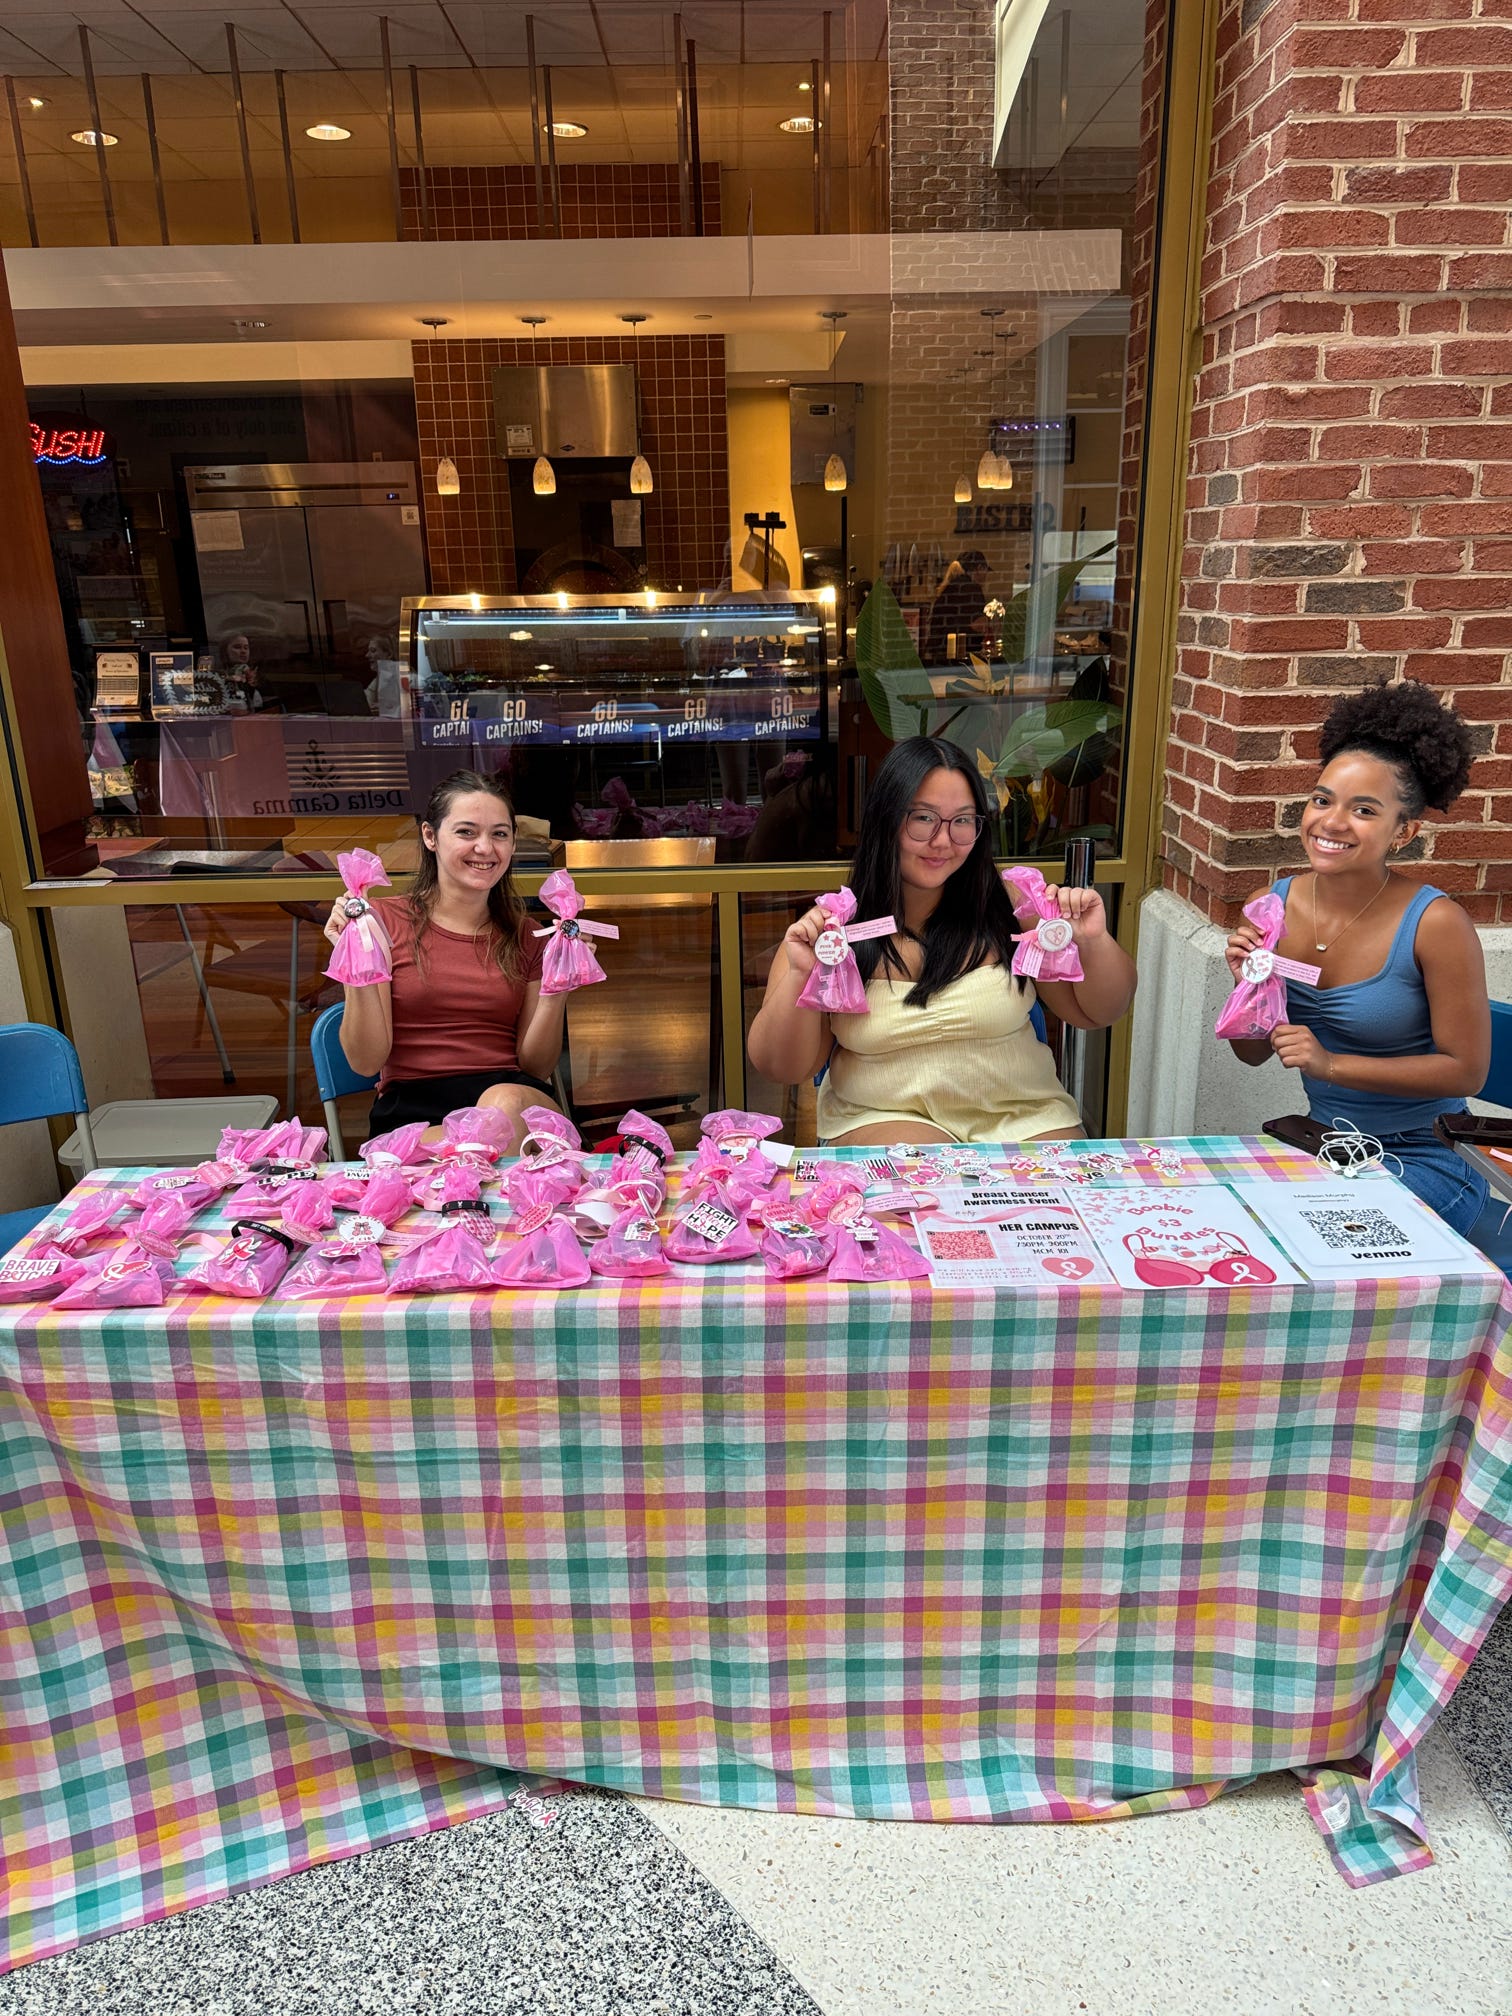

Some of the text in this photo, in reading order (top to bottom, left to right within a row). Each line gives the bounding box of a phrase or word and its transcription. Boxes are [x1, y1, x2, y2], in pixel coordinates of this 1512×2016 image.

[503, 699, 526, 722] GO
[595, 699, 618, 721] GO
[684, 697, 707, 720] GO
[771, 695, 793, 718] GO
[486, 719, 543, 740] CAPTAINS!
[577, 719, 633, 738] CAPTAINS!
[667, 718, 724, 737] CAPTAINS!
[755, 714, 810, 735] CAPTAINS!
[963, 1198, 1027, 1206] Awareness
[1126, 1203, 1194, 1216] Boobie
[698, 1202, 736, 1226] FIGHT
[1158, 1218, 1183, 1228] $3
[998, 1222, 1080, 1231] HER CAMPUS
[1135, 1226, 1217, 1241] Bundles
[1351, 1250, 1412, 1260] venmo
[4, 1260, 58, 1270] BRAVE
